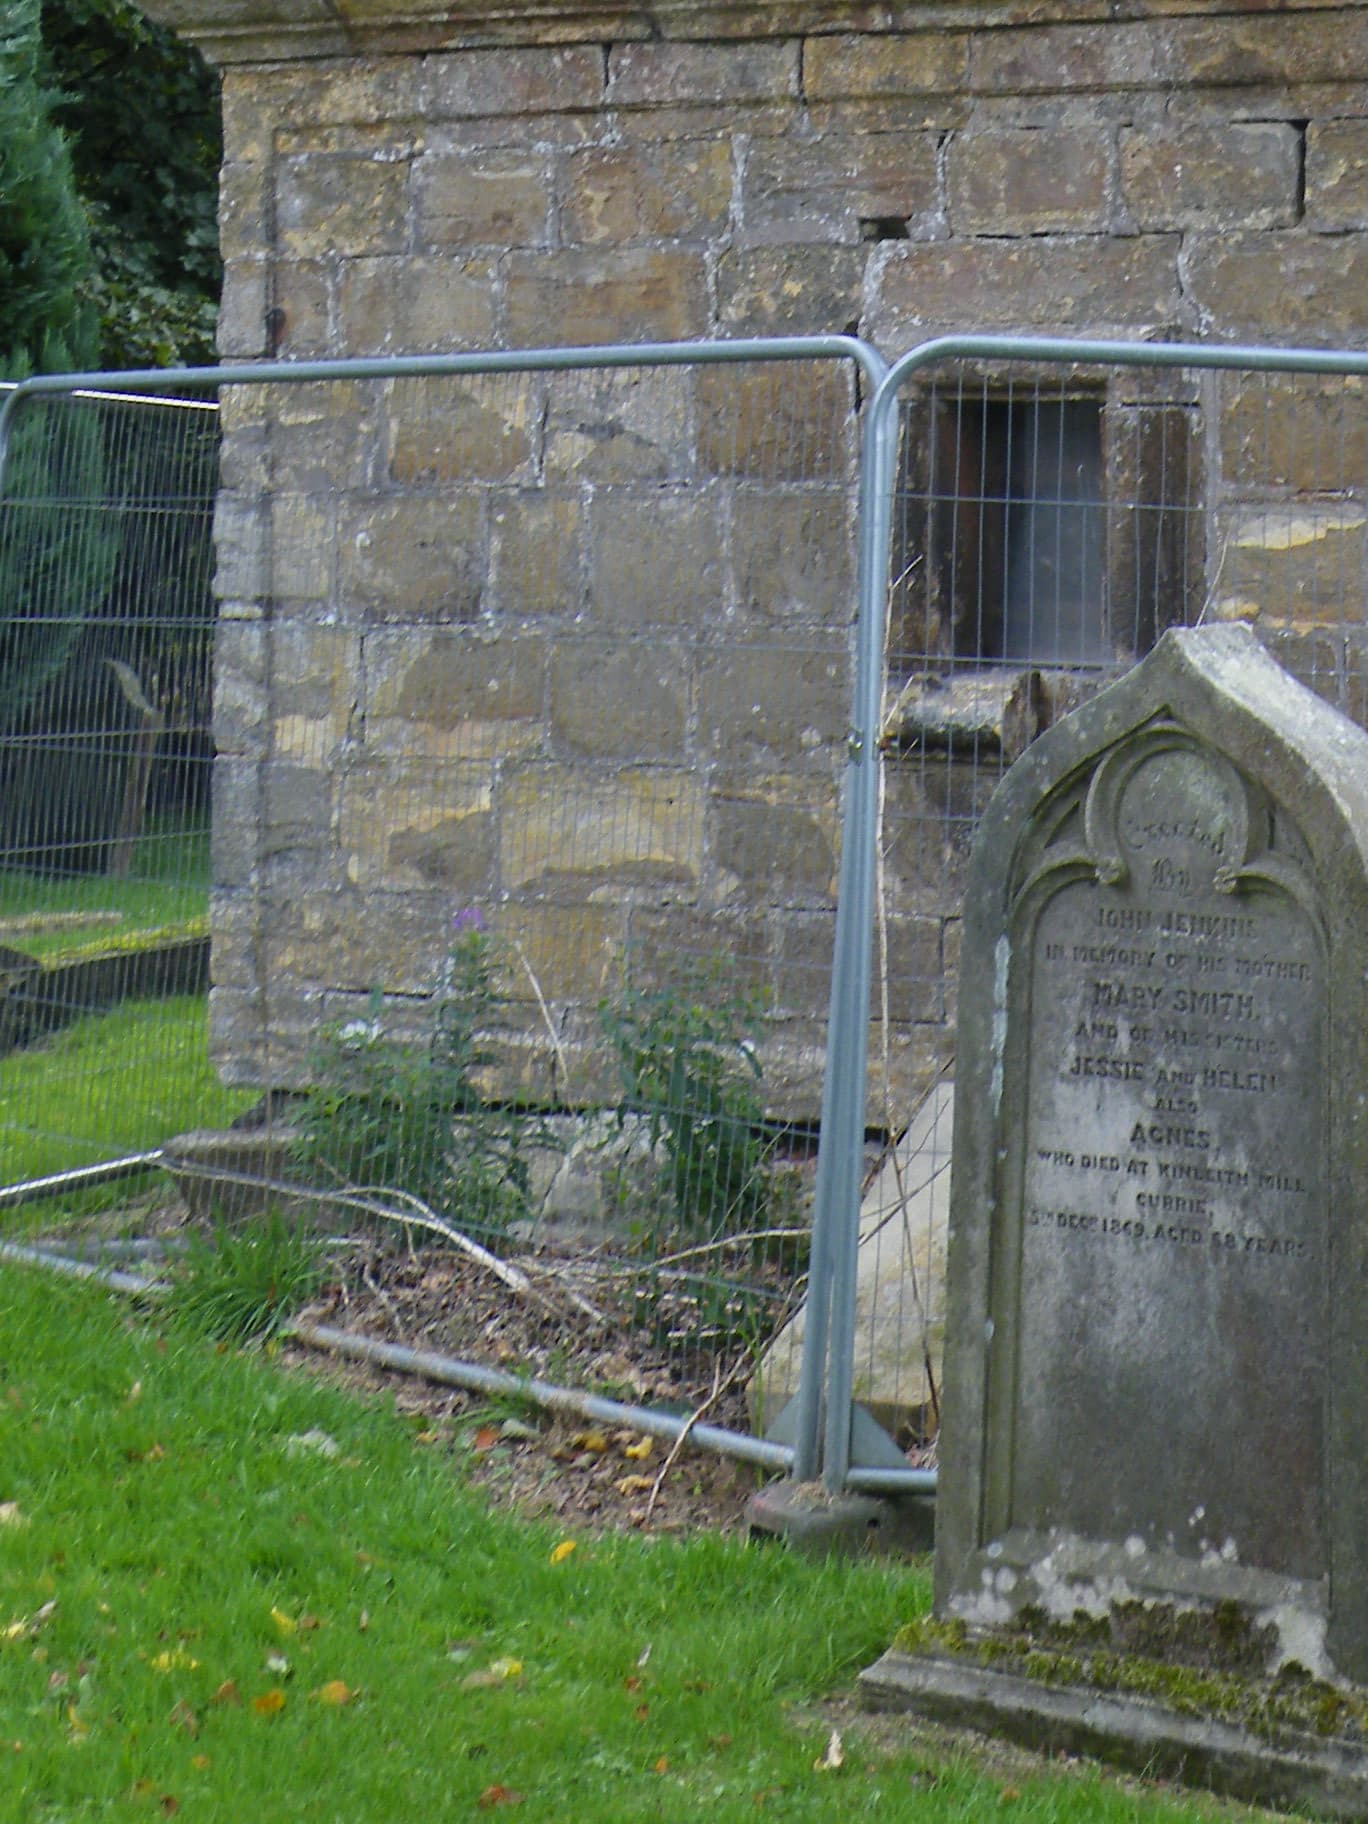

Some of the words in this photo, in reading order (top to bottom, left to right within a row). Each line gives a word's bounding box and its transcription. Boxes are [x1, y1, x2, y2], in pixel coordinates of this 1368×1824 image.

[1069, 1056, 1145, 1082] JESSIE
[1153, 1097, 1197, 1114] ALSO
[1037, 1149, 1074, 1167] WHO
[1081, 1154, 1120, 1172] DIED
[1126, 1159, 1149, 1176] AT
